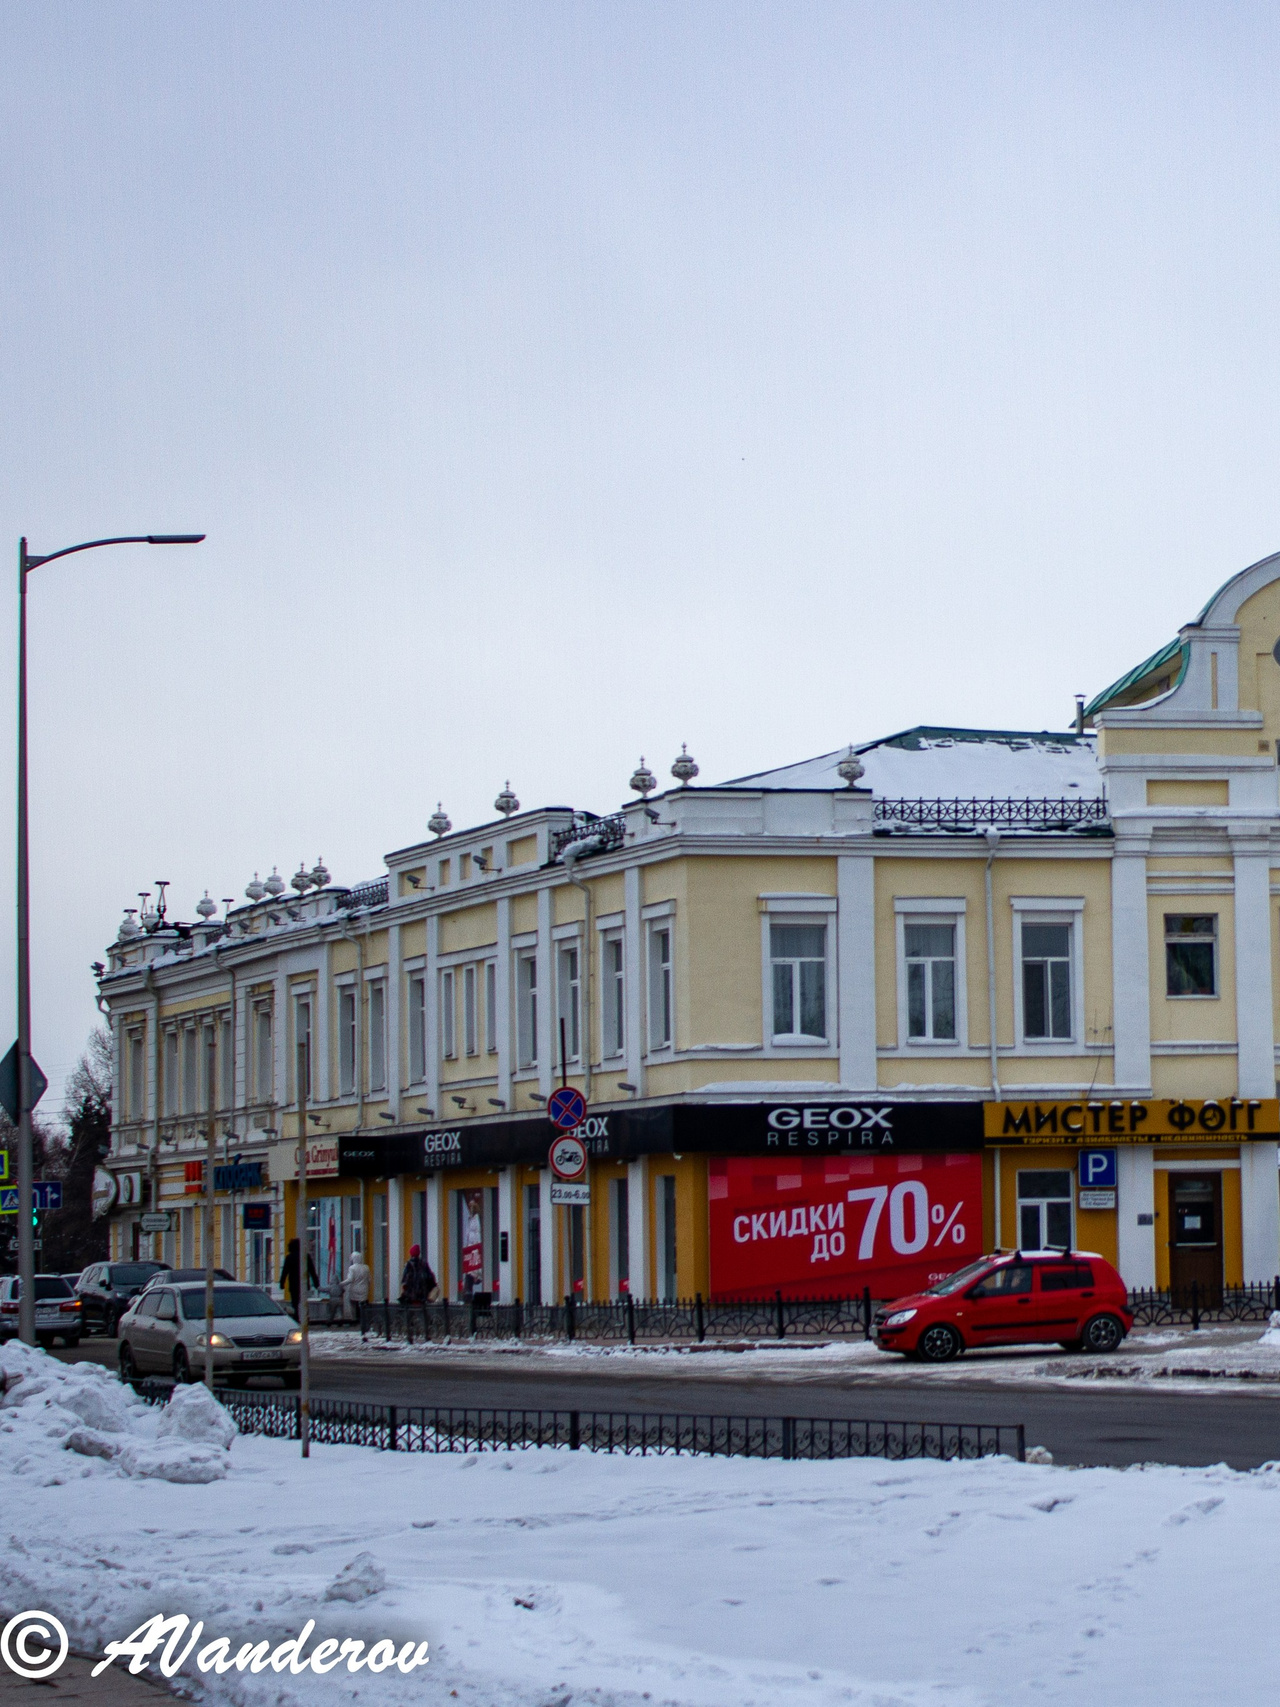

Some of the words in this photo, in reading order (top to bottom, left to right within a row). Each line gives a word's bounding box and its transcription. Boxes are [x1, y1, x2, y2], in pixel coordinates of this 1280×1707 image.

[767, 1107, 894, 1129] GEOX
[1003, 1102, 1148, 1134] МИСТЕР
[1168, 1101, 1262, 1131] ФОГГ
[424, 1131, 462, 1153] GEOX
[767, 1131, 894, 1147] RESPIRA
[424, 1153, 462, 1168] RESPIRA
[733, 1202, 845, 1243] СКИДКИ
[811, 1231, 846, 1263] ДО
[847, 1180, 966, 1260] 70%
